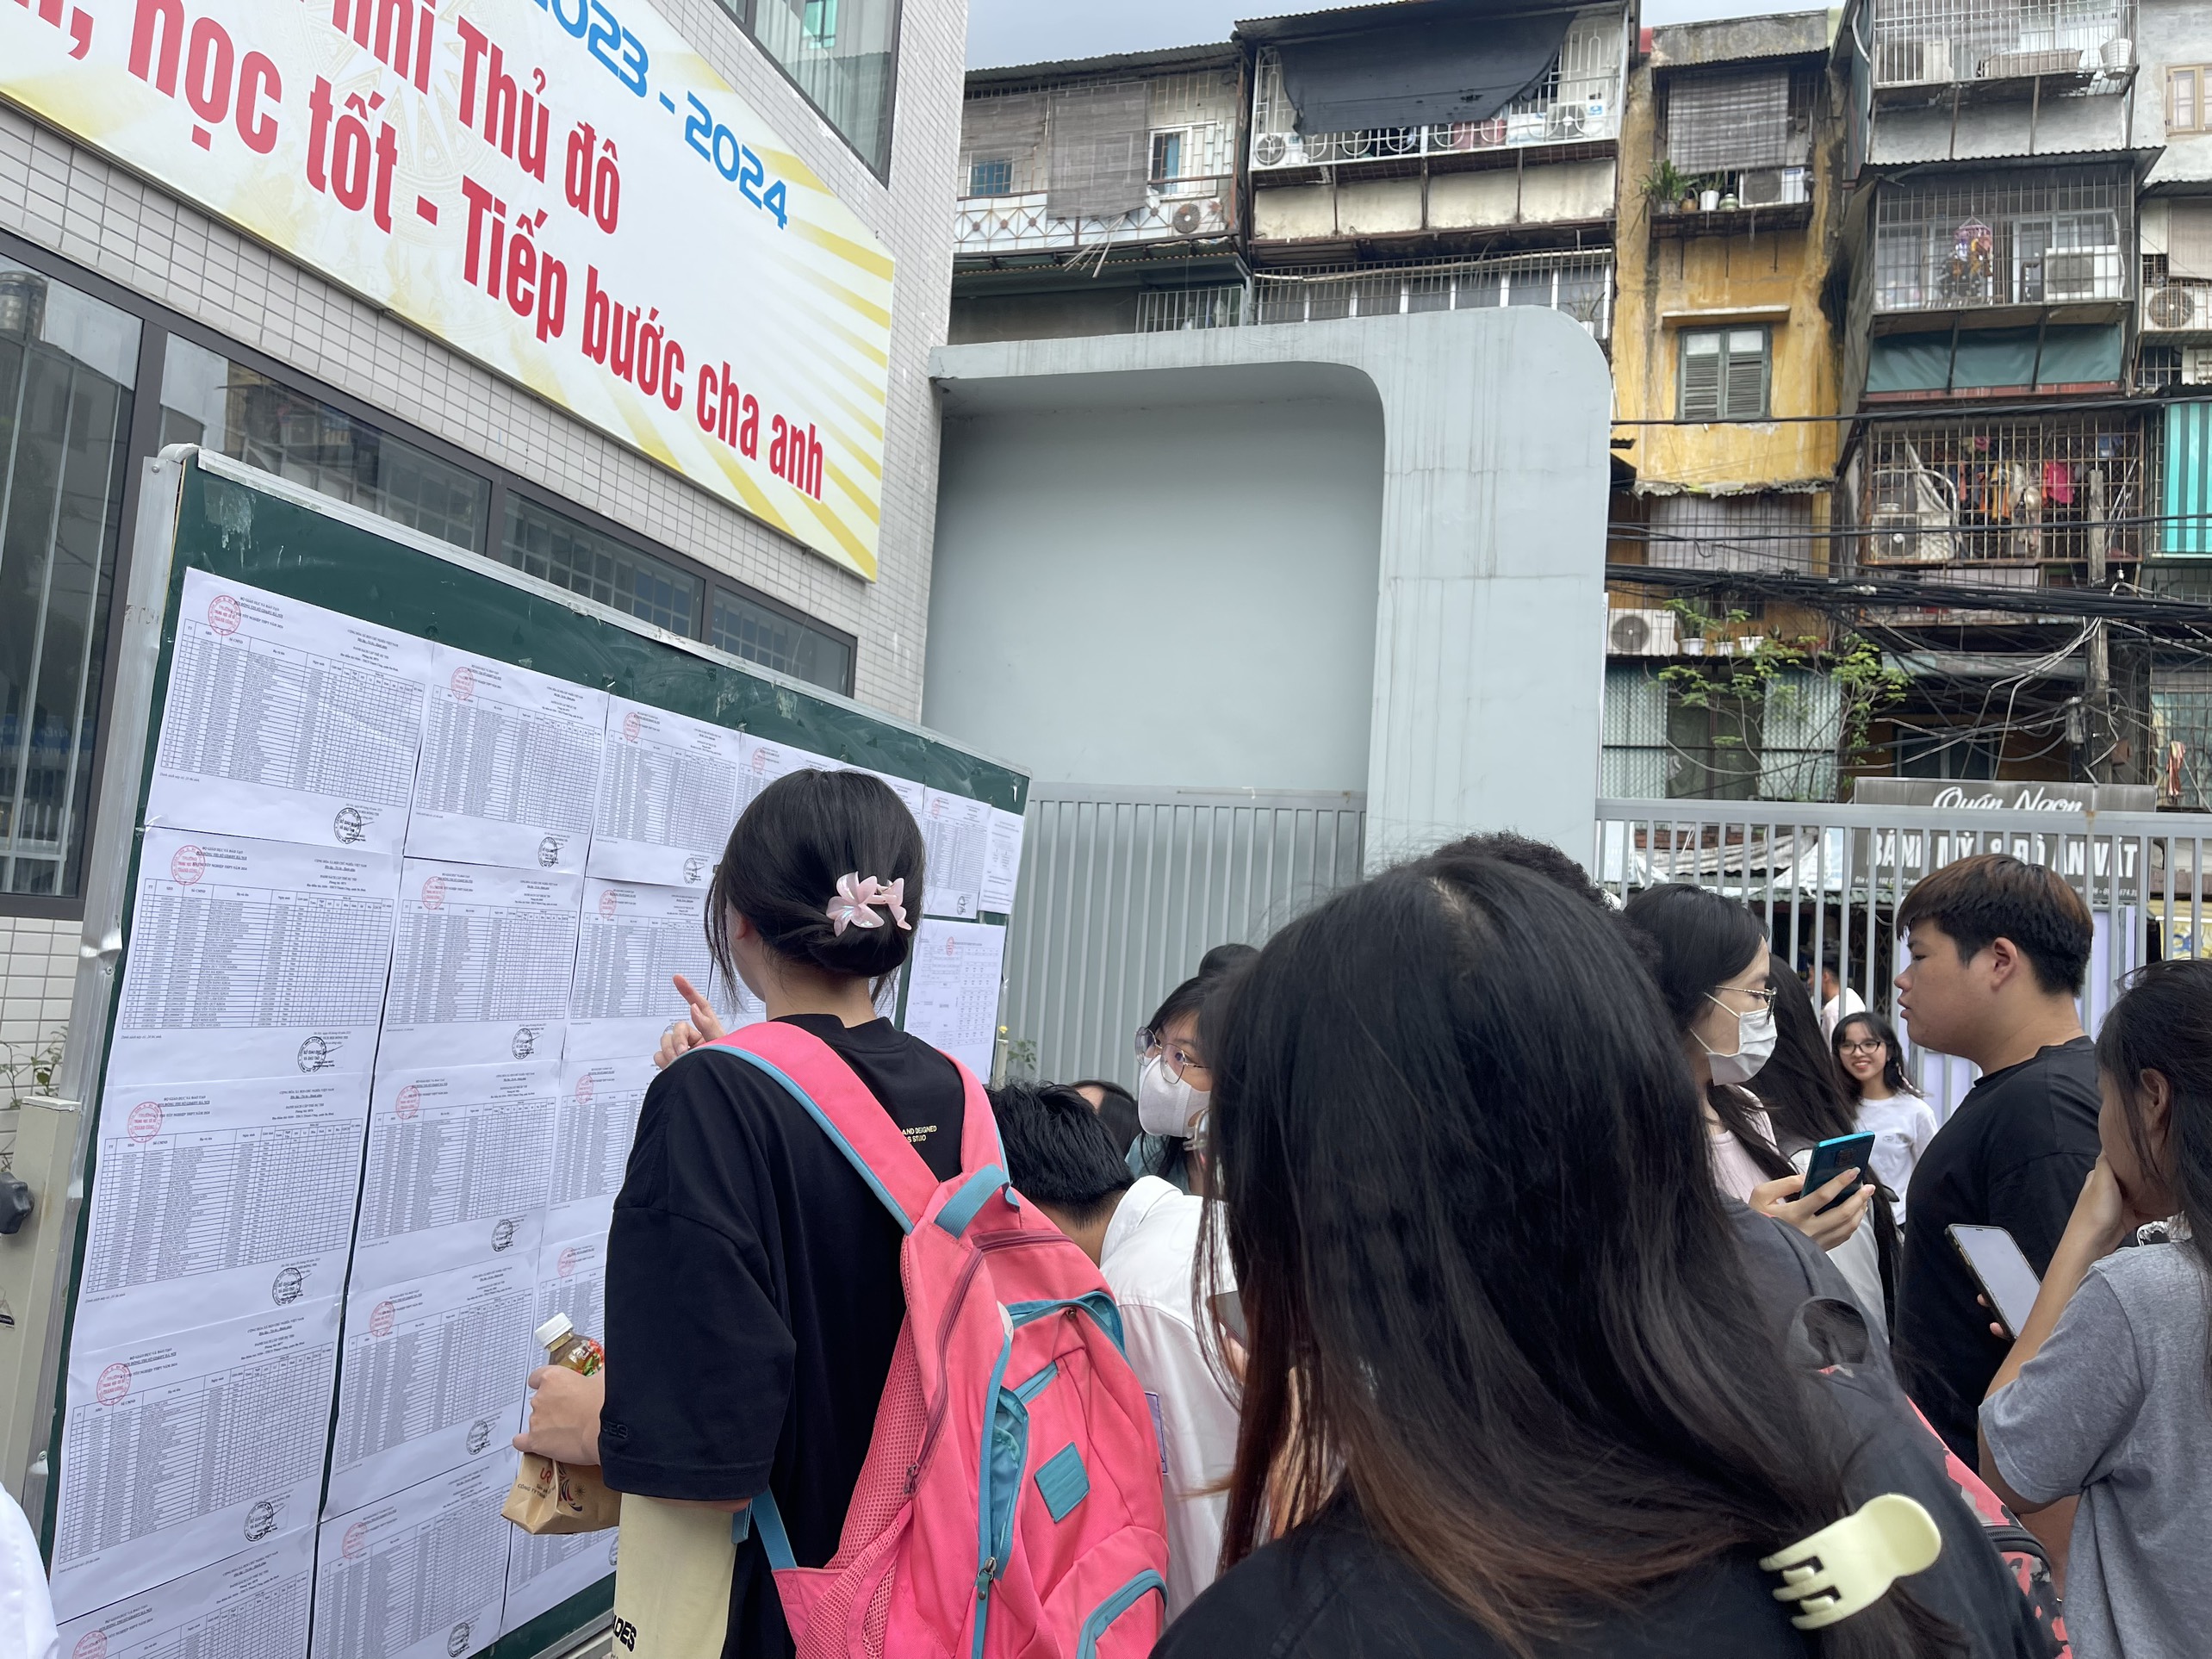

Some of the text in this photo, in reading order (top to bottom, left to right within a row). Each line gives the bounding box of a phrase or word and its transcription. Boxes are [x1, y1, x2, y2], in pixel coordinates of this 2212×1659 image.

[457, 15, 550, 184] Thủ
[564, 121, 620, 234] đô
[525, 0, 787, 230] 023 - 2024
[127, 0, 283, 154] học
[307, 74, 398, 234] tốt
[416, 195, 438, 226] -
[462, 175, 569, 344] Tiếp
[581, 264, 686, 412] bước
[697, 360, 760, 462] cha
[769, 413, 823, 501] anh
